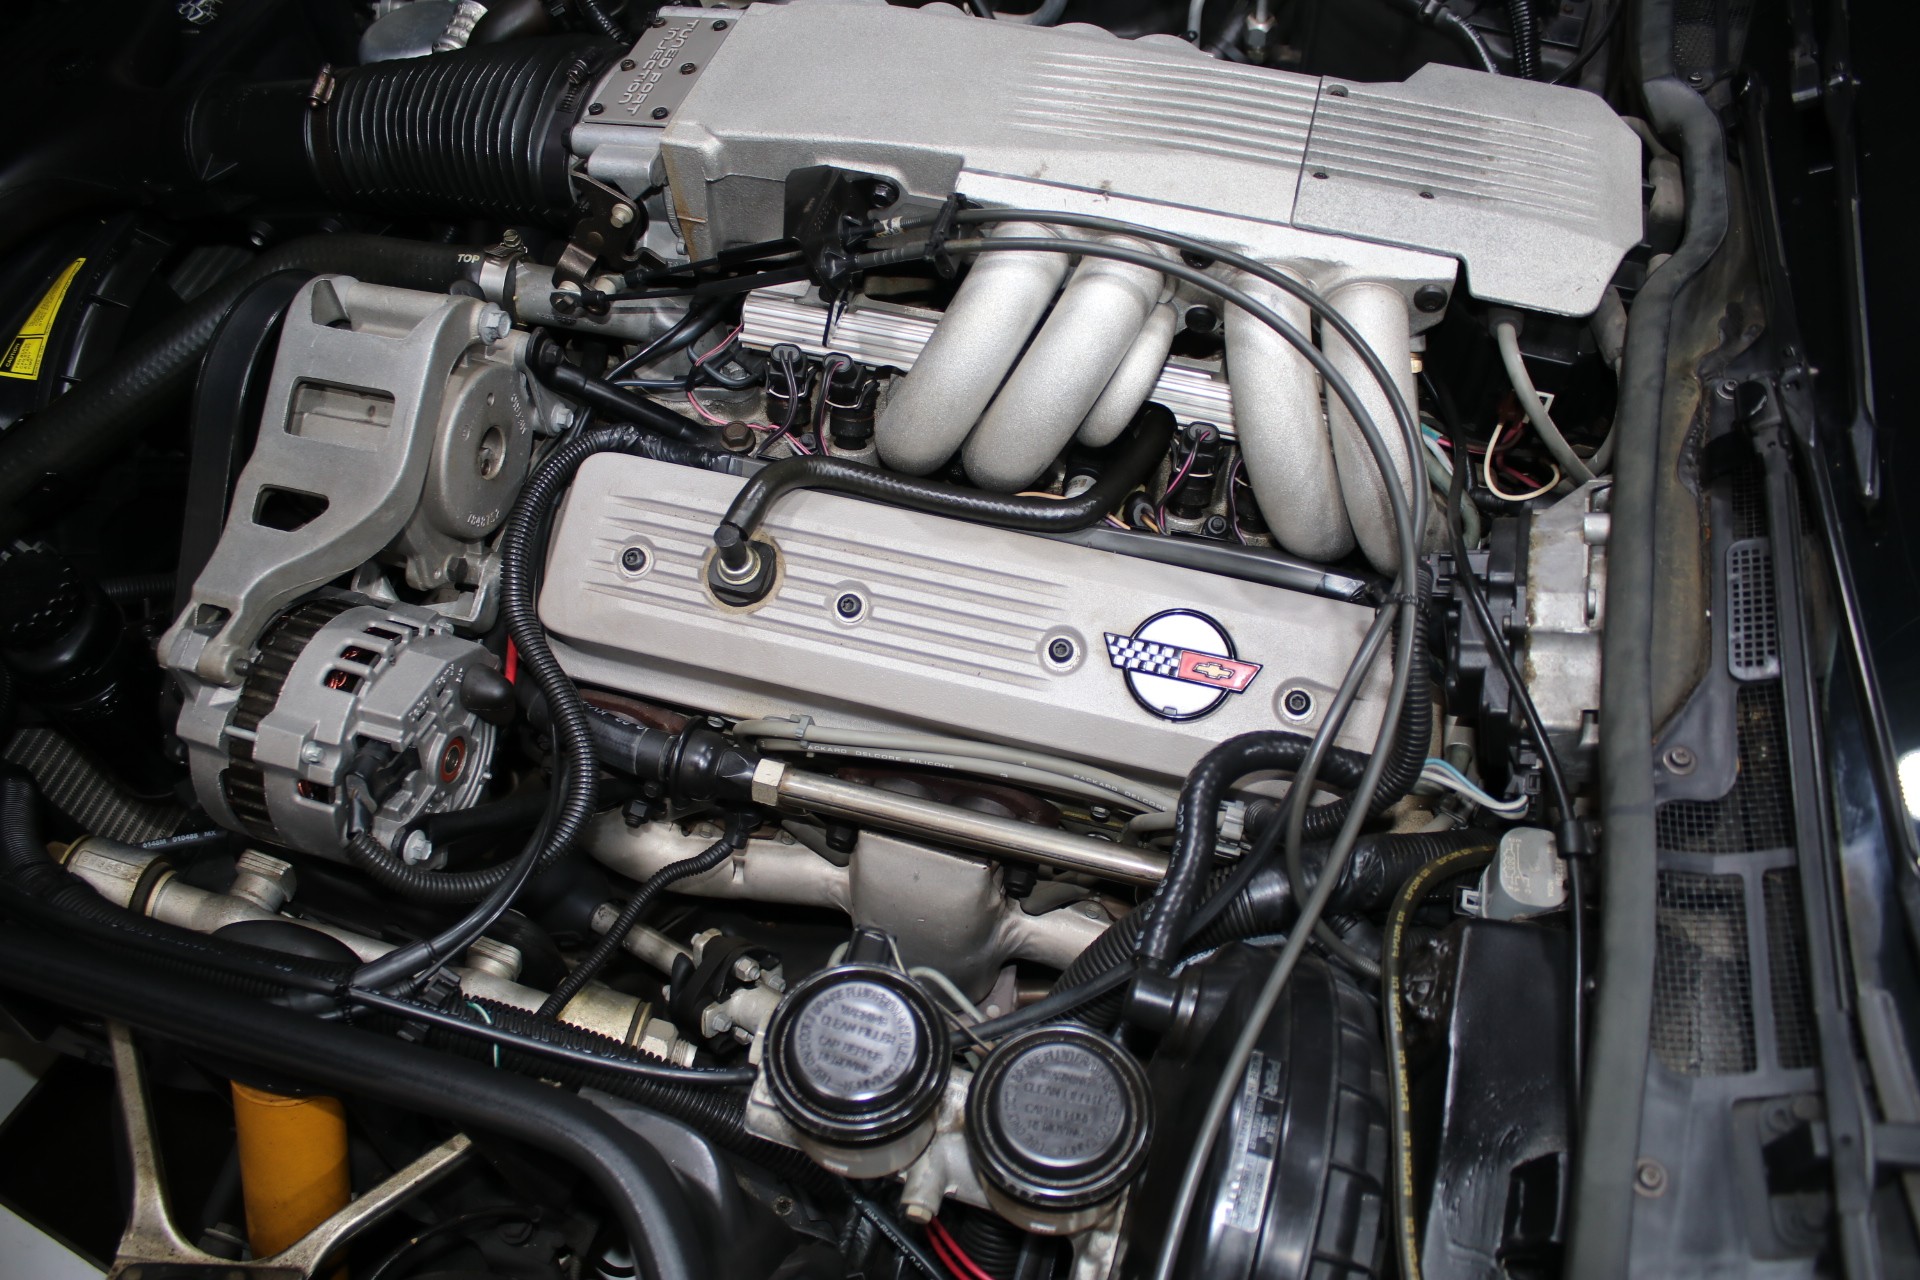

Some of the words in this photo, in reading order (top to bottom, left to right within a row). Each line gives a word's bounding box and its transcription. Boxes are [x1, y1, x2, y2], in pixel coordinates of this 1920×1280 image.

[658, 19, 700, 69] TUNED
[618, 27, 680, 104] INJECTION
[627, 72, 662, 116] PORT
[457, 253, 480, 264] TOP
[5, 343, 20, 368] CAUTION
[806, 744, 847, 754] ACKARD
[855, 750, 901, 762] DELCORE
[909, 758, 955, 769] SILICONE
[1073, 773, 1118, 792] PACKARD
[1124, 790, 1168, 811] DELCORE
[1262, 1058, 1282, 1096] PBR
